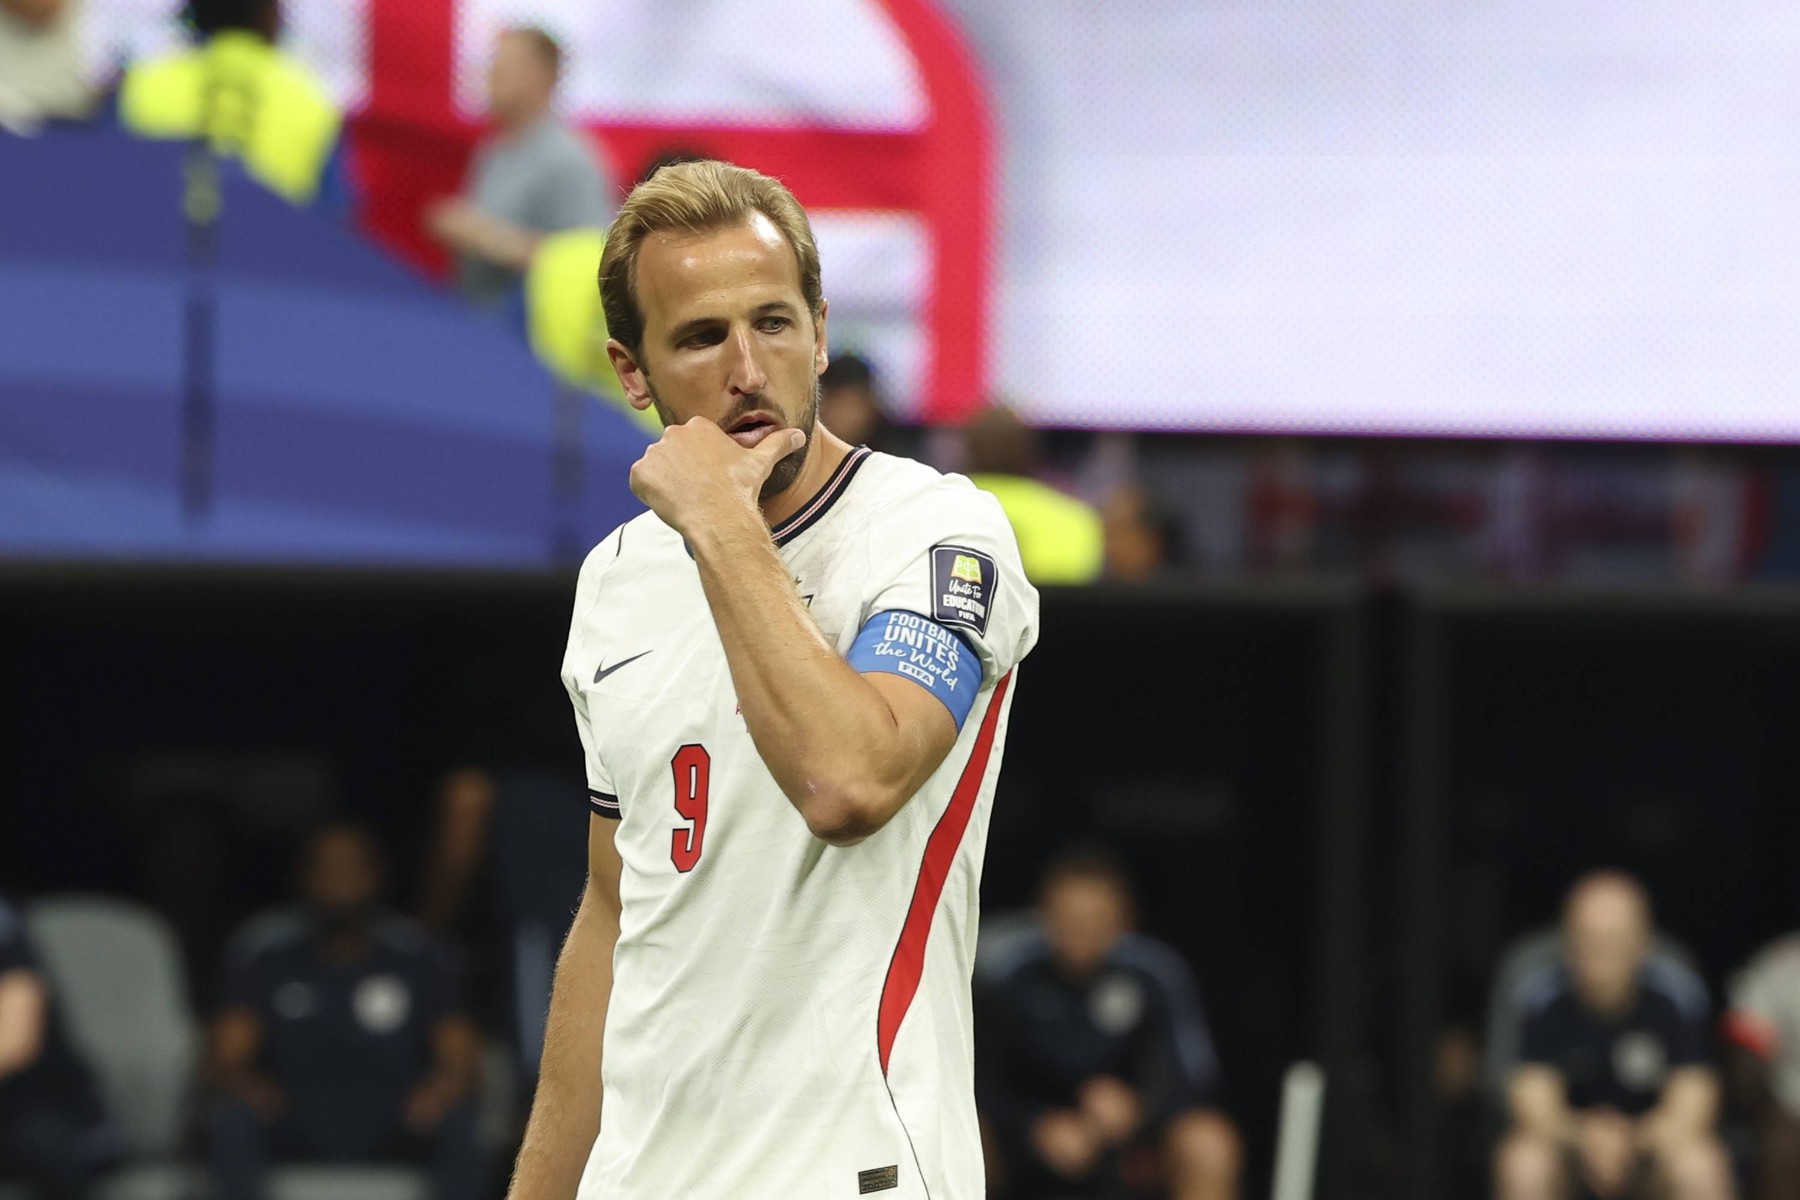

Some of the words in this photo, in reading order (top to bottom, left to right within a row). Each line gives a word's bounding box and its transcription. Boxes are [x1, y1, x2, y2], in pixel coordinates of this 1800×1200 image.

[948, 579, 973, 595] Unite
[971, 585, 983, 599] For
[942, 594, 986, 619] EDUCATION
[958, 610, 976, 622] FIFA
[884, 625, 958, 671] UNITES
[889, 612, 959, 655] FOOTBALL
[872, 641, 907, 657] the
[910, 648, 958, 691] World
[901, 663, 933, 686] FIFA
[671, 743, 711, 873] 9
